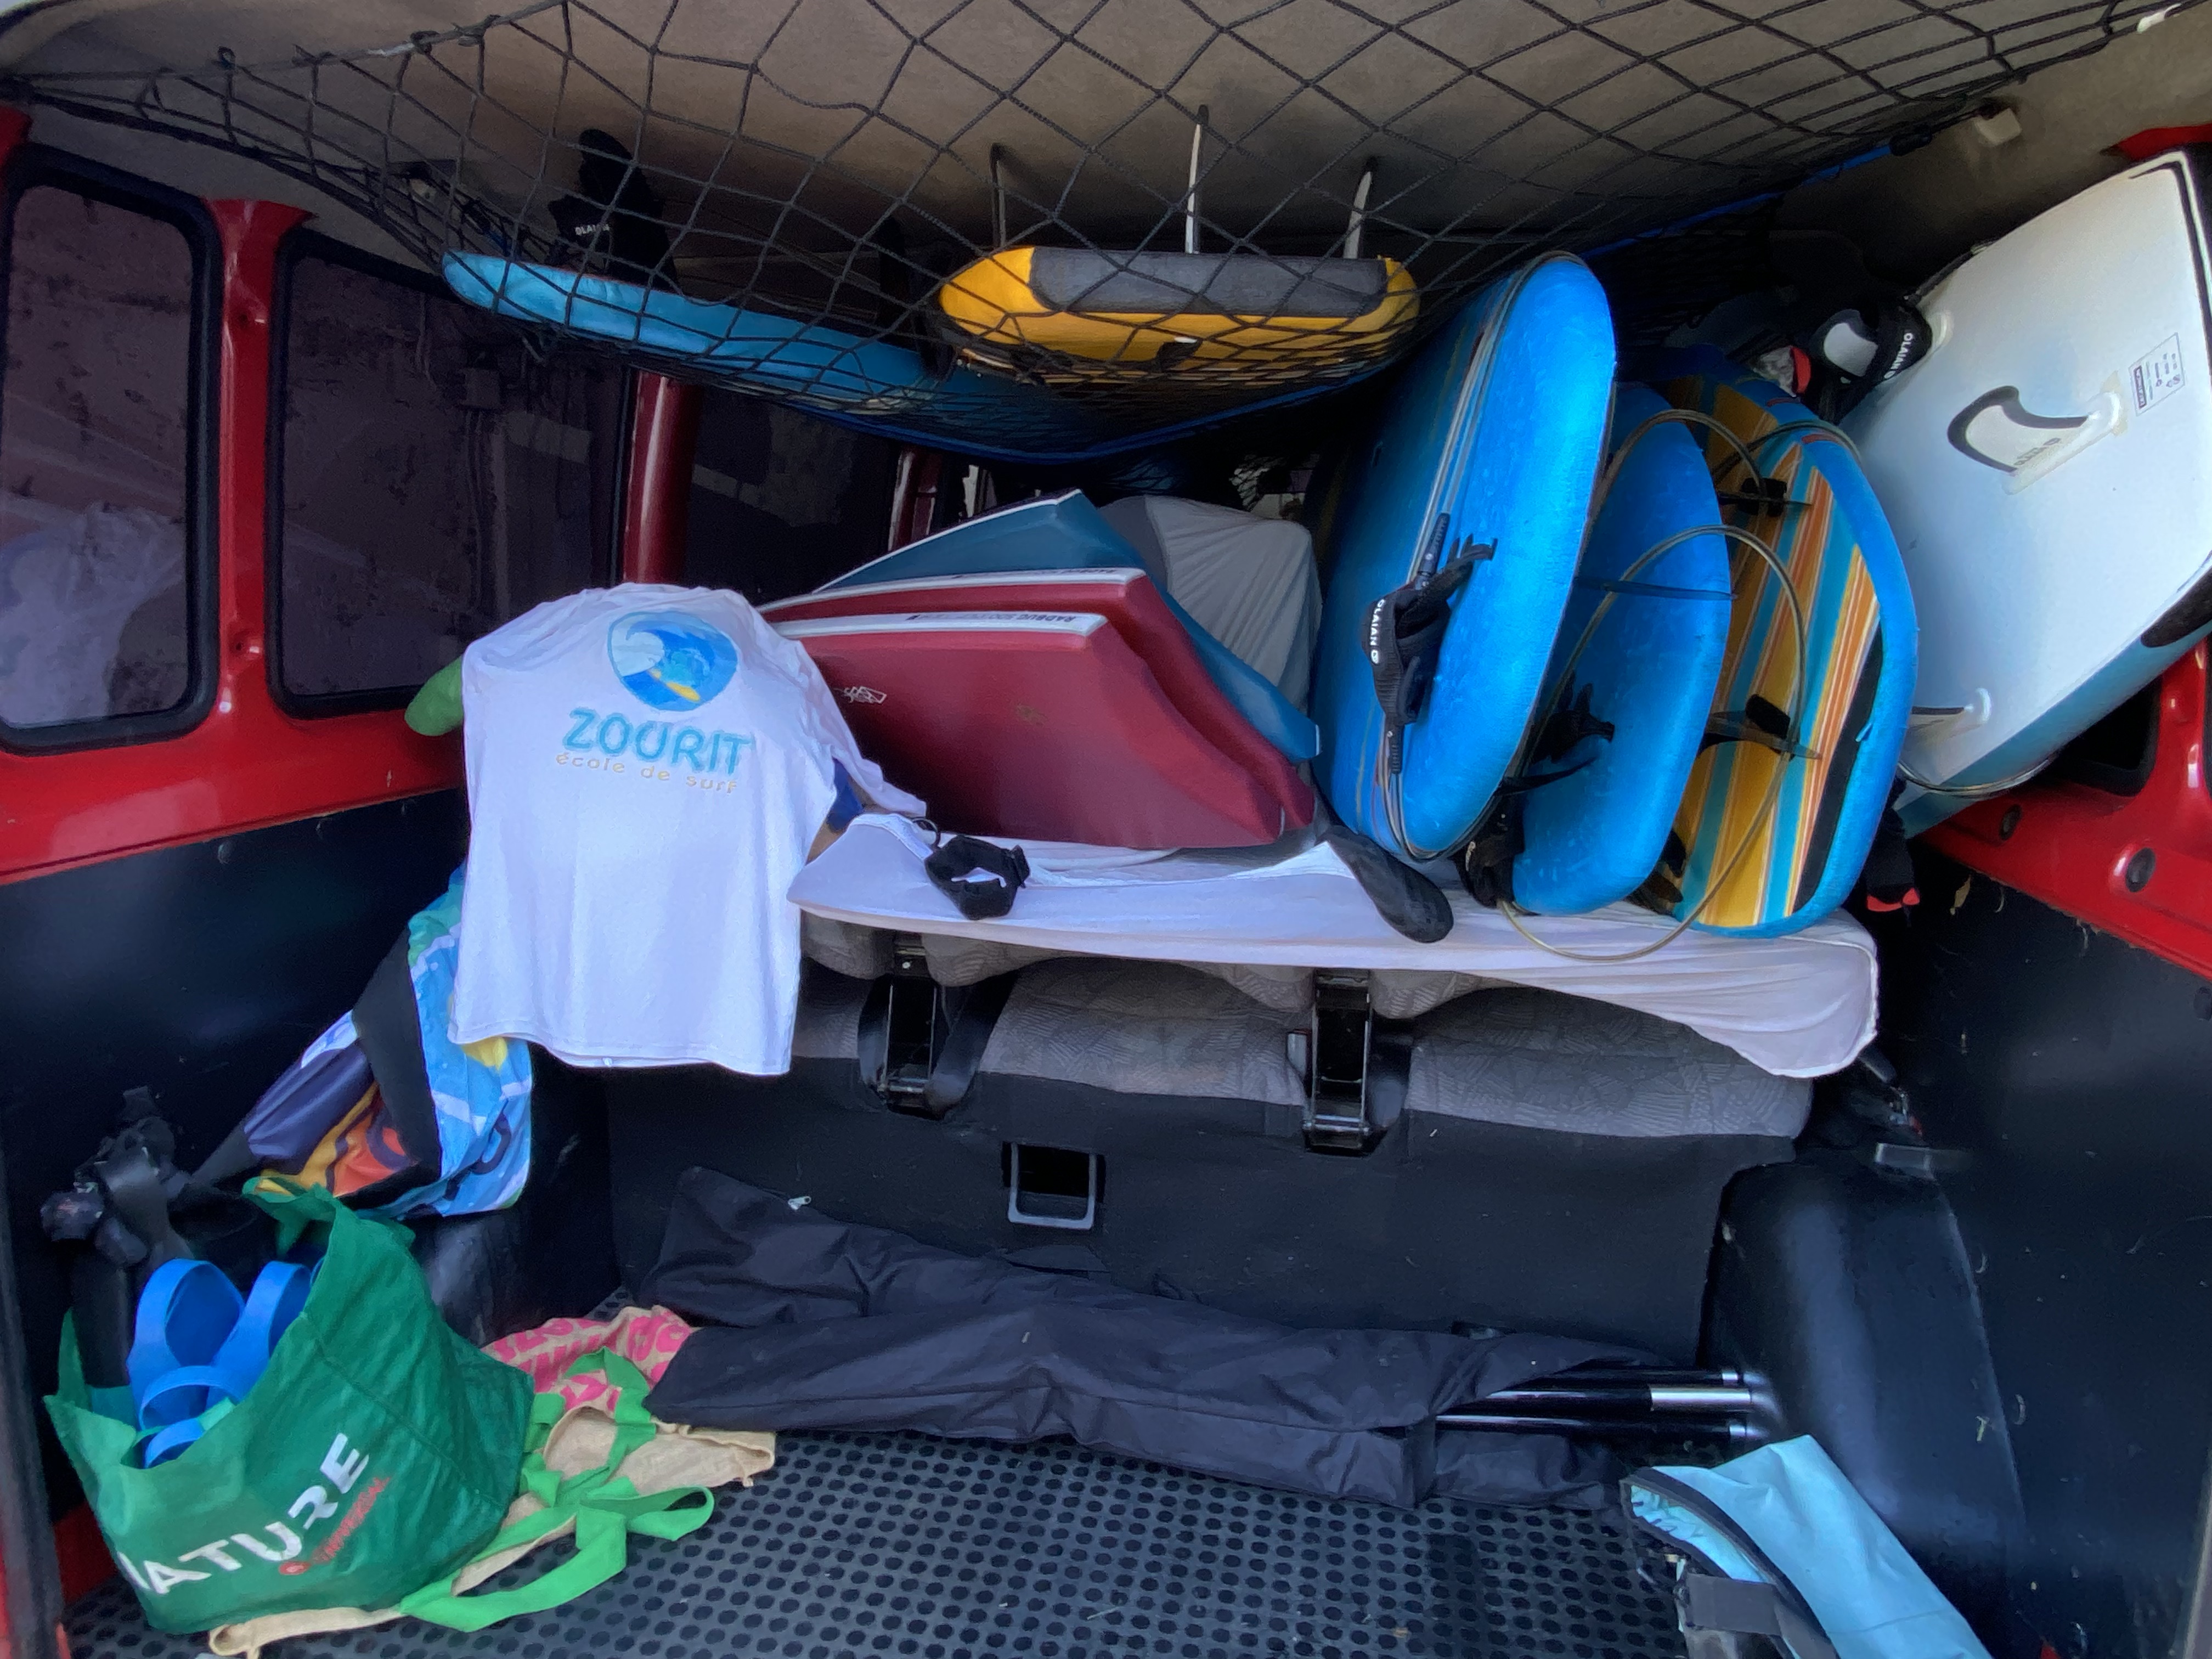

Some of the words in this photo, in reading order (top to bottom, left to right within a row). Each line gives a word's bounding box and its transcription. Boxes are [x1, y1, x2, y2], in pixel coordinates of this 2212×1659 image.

[1891, 332, 1914, 369] OLAIAN
[1370, 599, 1385, 645] OLAIAN
[563, 708, 754, 775] ZOURIT
[556, 752, 625, 772] école
[640, 765, 670, 781] de
[685, 775, 738, 794] surf
